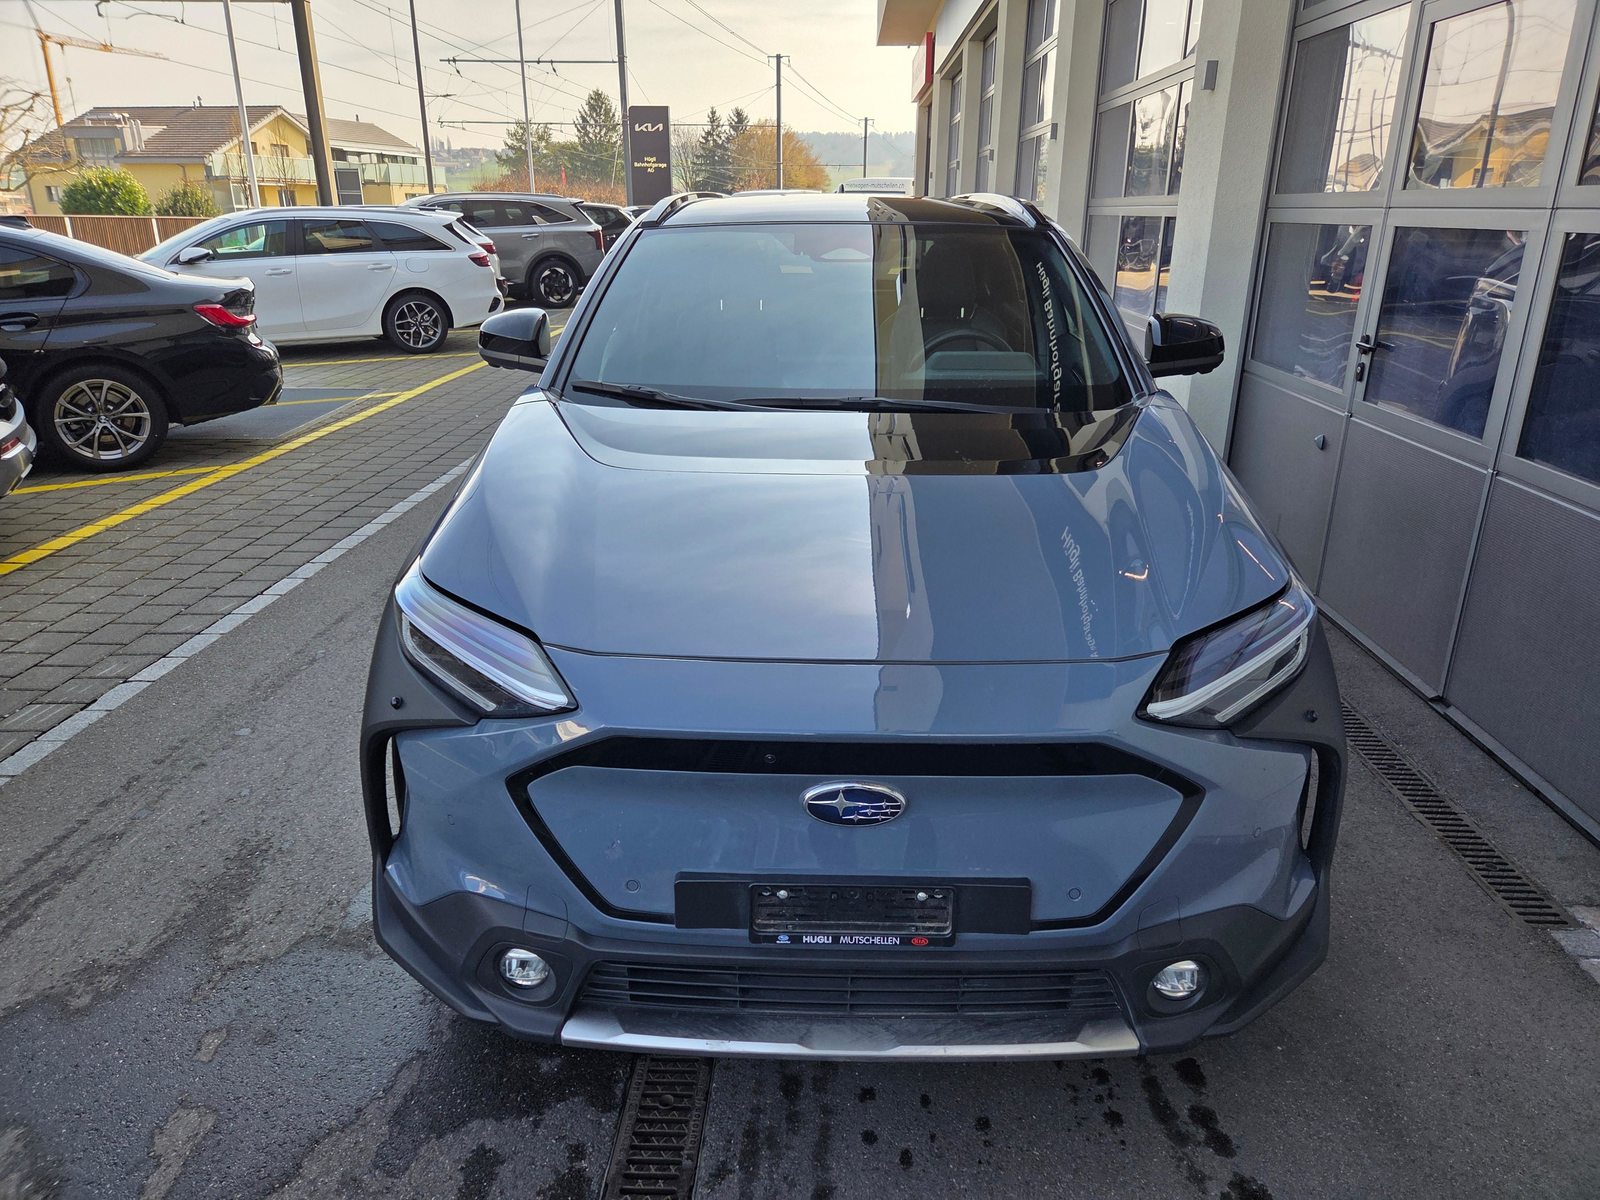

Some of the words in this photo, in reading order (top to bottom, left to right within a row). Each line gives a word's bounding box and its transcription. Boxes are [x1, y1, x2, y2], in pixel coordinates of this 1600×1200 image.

[634, 123, 664, 131] KIA
[802, 935, 832, 944] HUGLI
[839, 936, 900, 945] MUTSCHELLEN
